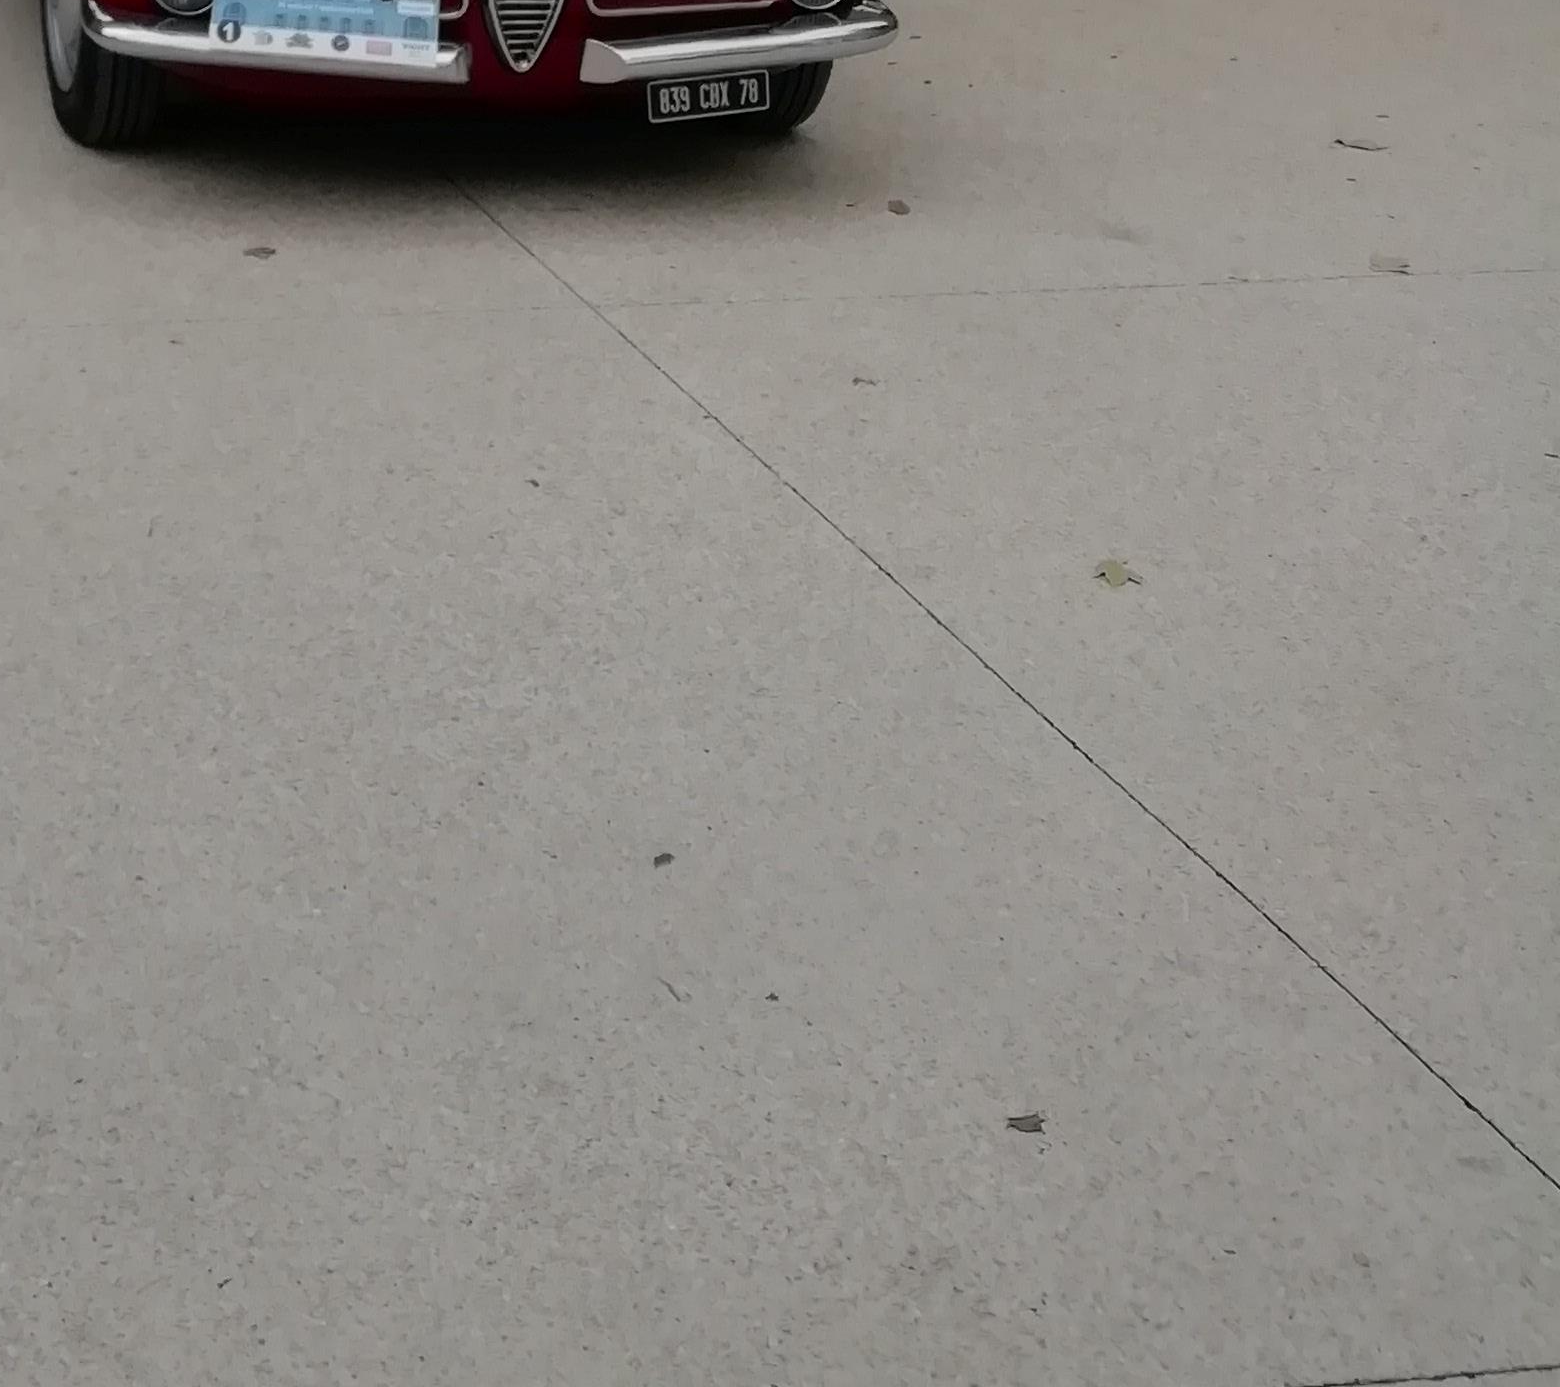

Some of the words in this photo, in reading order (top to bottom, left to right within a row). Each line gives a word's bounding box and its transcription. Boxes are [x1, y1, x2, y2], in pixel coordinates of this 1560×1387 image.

[222, 21, 235, 41] 1
[699, 81, 730, 110] CBX
[739, 78, 759, 106] 78
